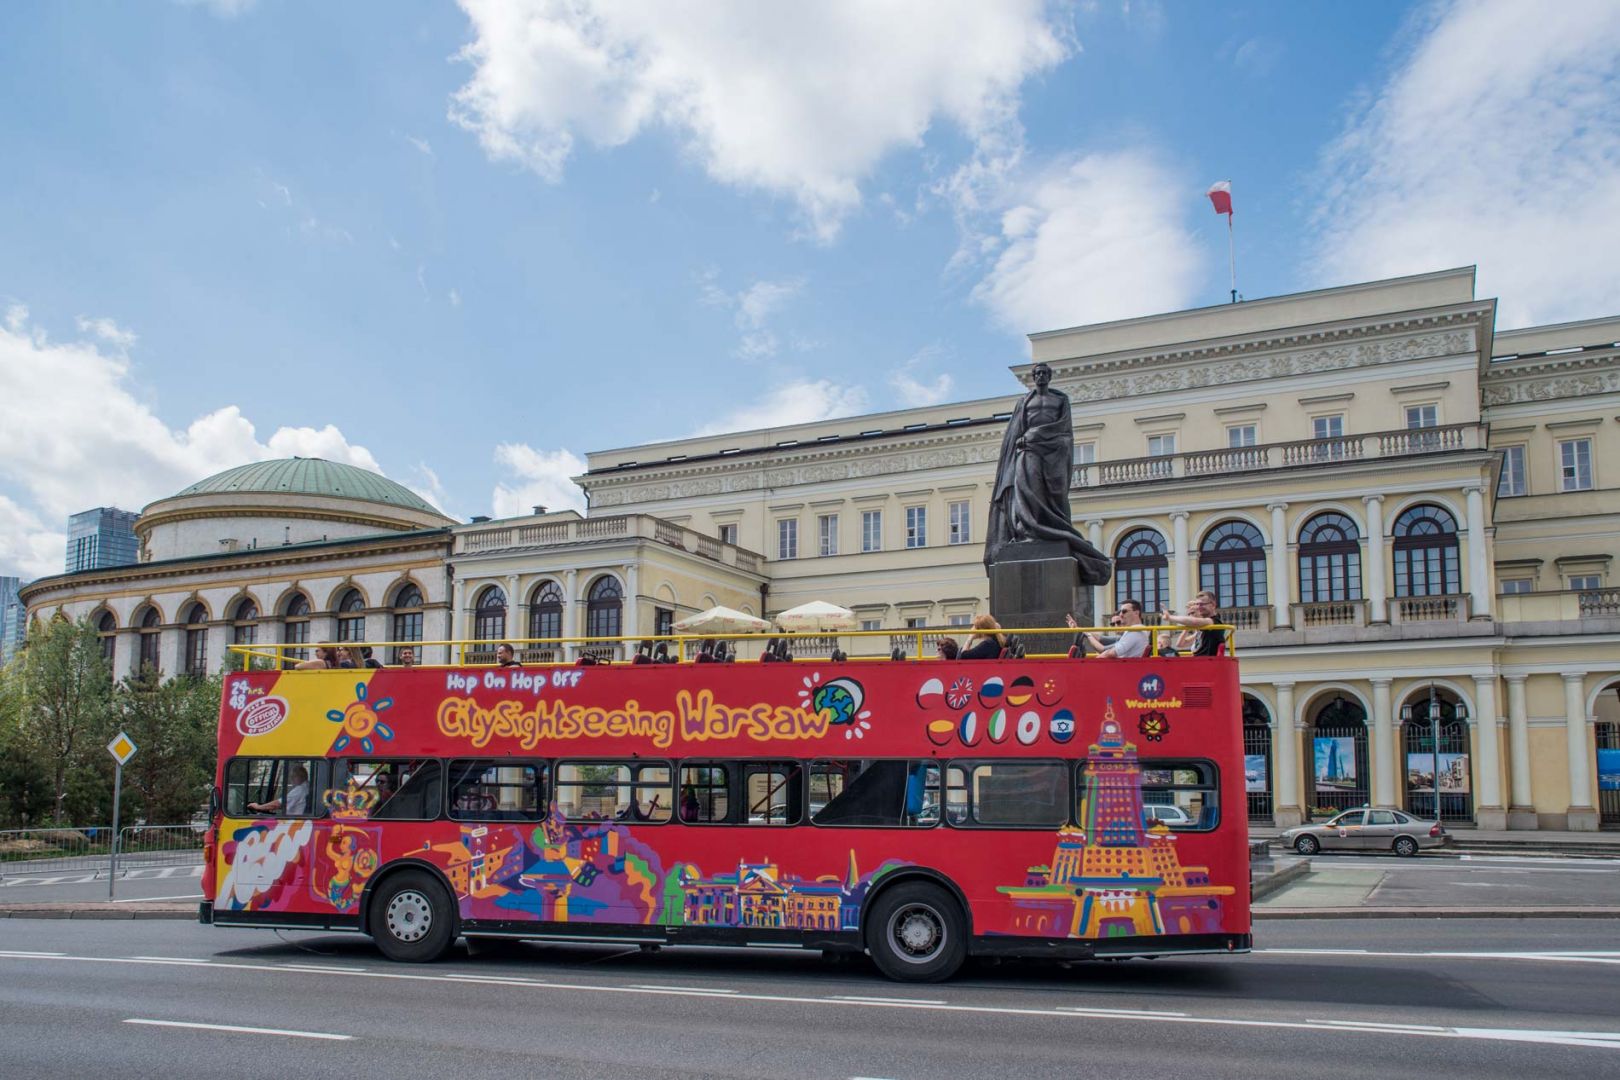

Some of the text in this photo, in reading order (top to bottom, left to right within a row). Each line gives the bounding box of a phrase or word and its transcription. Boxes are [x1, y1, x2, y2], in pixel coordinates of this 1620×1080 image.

[231, 680, 249, 694] 24
[446, 673, 478, 694] Hop
[484, 671, 506, 688] On
[511, 671, 546, 694] Hop
[229, 694, 246, 710] 48
[1125, 697, 1182, 709] Worldwide
[677, 689, 831, 741] Warsaw
